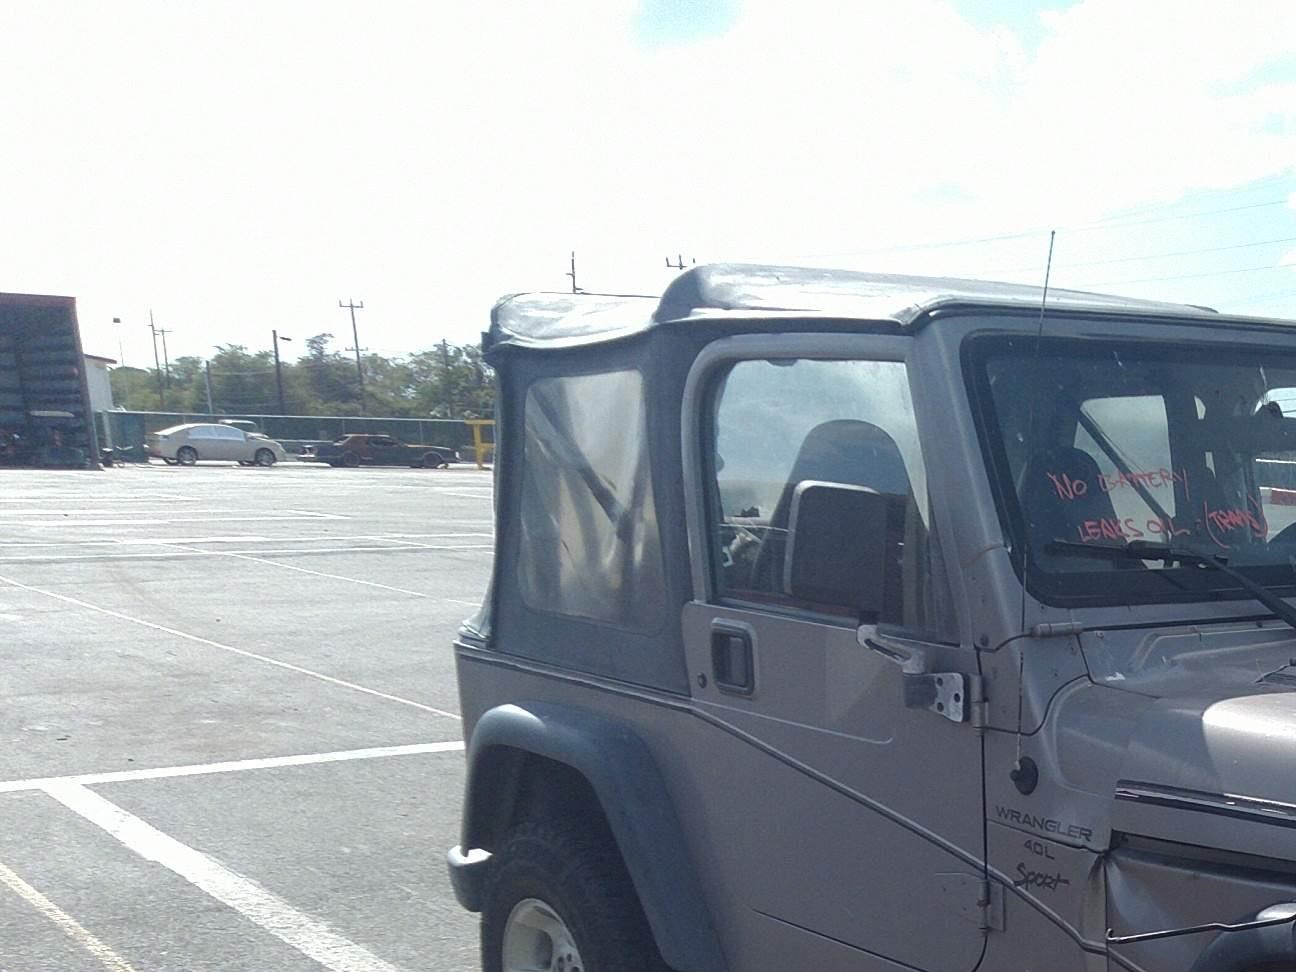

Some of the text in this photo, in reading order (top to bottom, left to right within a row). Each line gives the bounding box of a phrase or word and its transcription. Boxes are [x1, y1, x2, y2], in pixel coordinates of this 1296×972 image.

[1097, 465, 1190, 501] BATTERY
[1077, 519, 1144, 543] LEAKS
[996, 807, 1094, 842] WRANGLER
[1014, 863, 1070, 891] Sport
